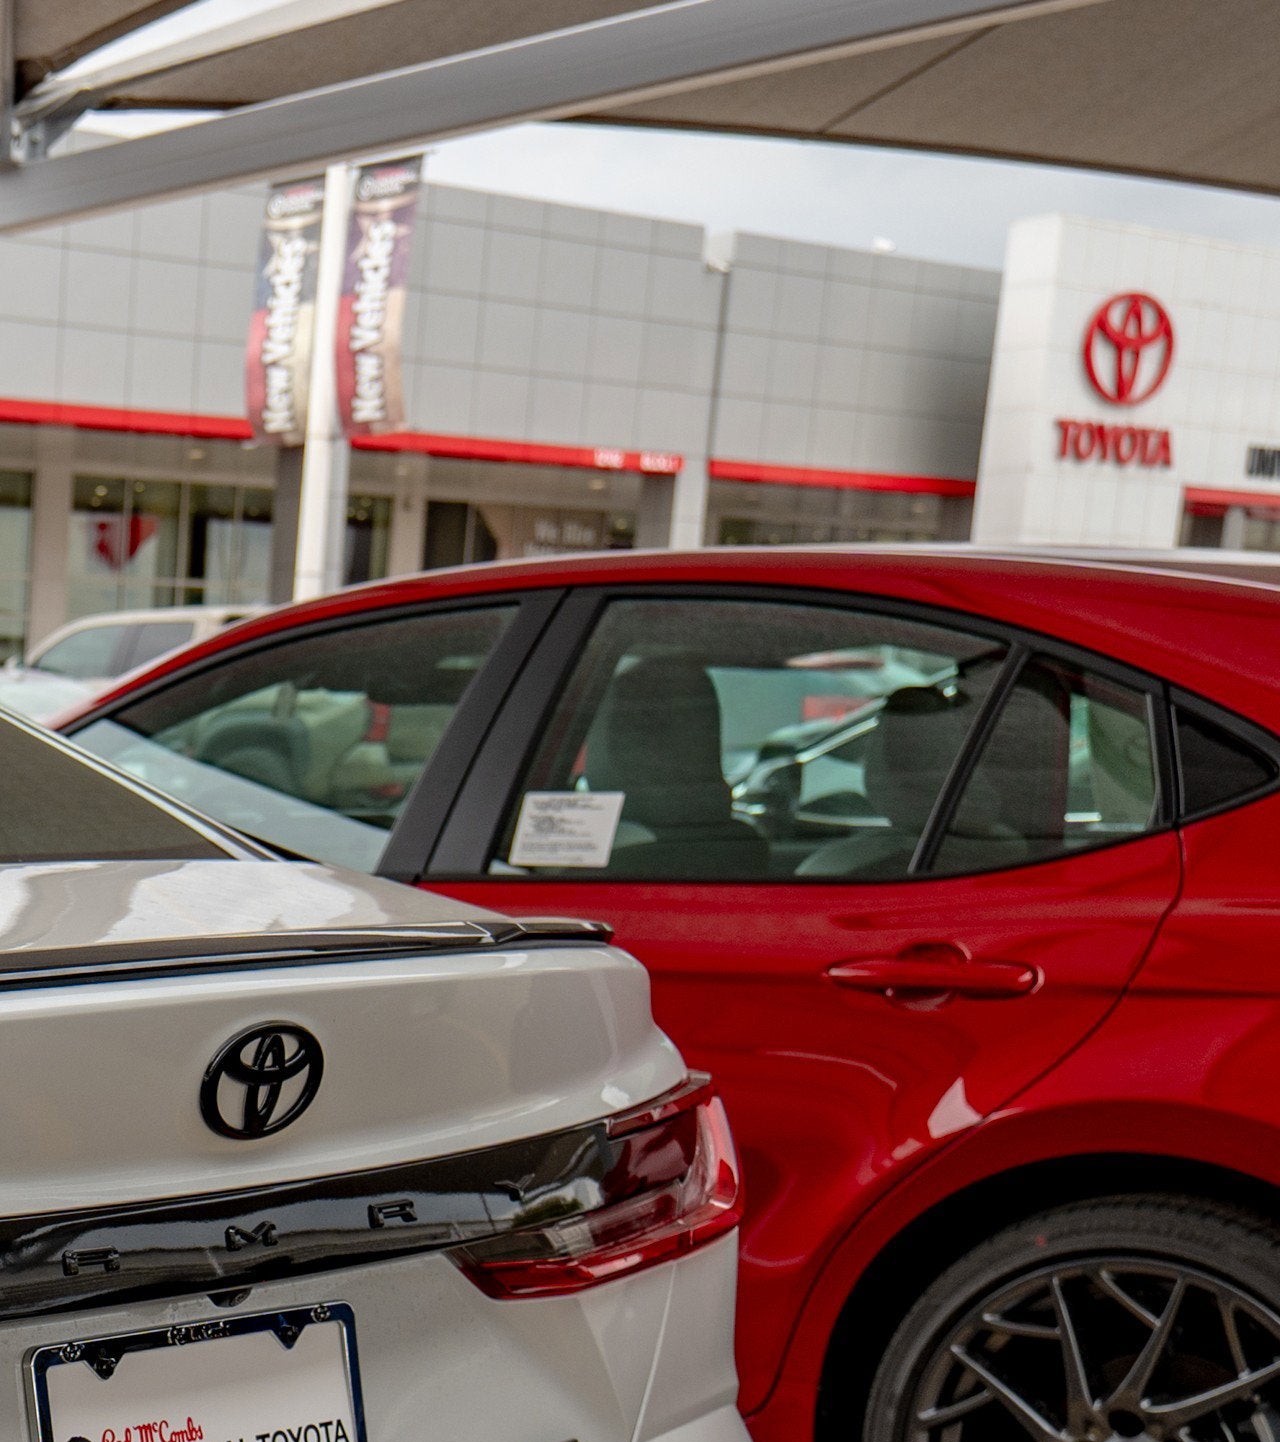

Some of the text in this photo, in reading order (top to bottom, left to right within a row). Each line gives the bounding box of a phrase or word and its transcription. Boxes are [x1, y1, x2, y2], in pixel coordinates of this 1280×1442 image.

[261, 237, 308, 365] Vehicles
[349, 220, 396, 351] Vehicles
[262, 366, 292, 433] New
[350, 354, 386, 424] New
[1055, 418, 1172, 469] TOYOTA
